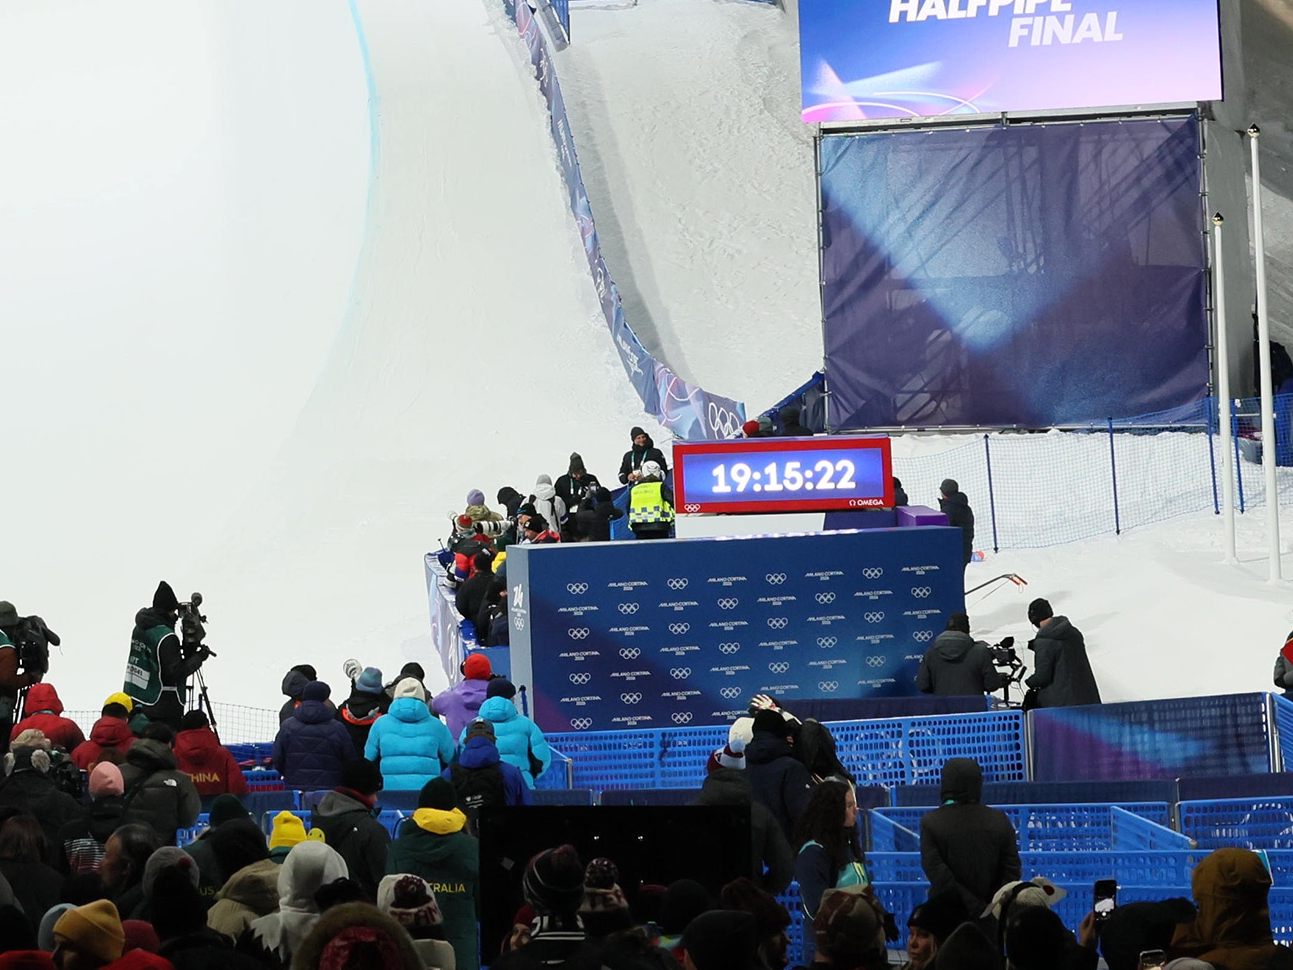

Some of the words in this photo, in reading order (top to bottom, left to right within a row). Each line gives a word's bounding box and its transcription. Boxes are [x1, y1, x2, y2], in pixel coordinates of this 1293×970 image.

[1008, 11, 1124, 48] FINAL
[712, 460, 856, 493] 19:15:22
[186, 772, 220, 783] HINA
